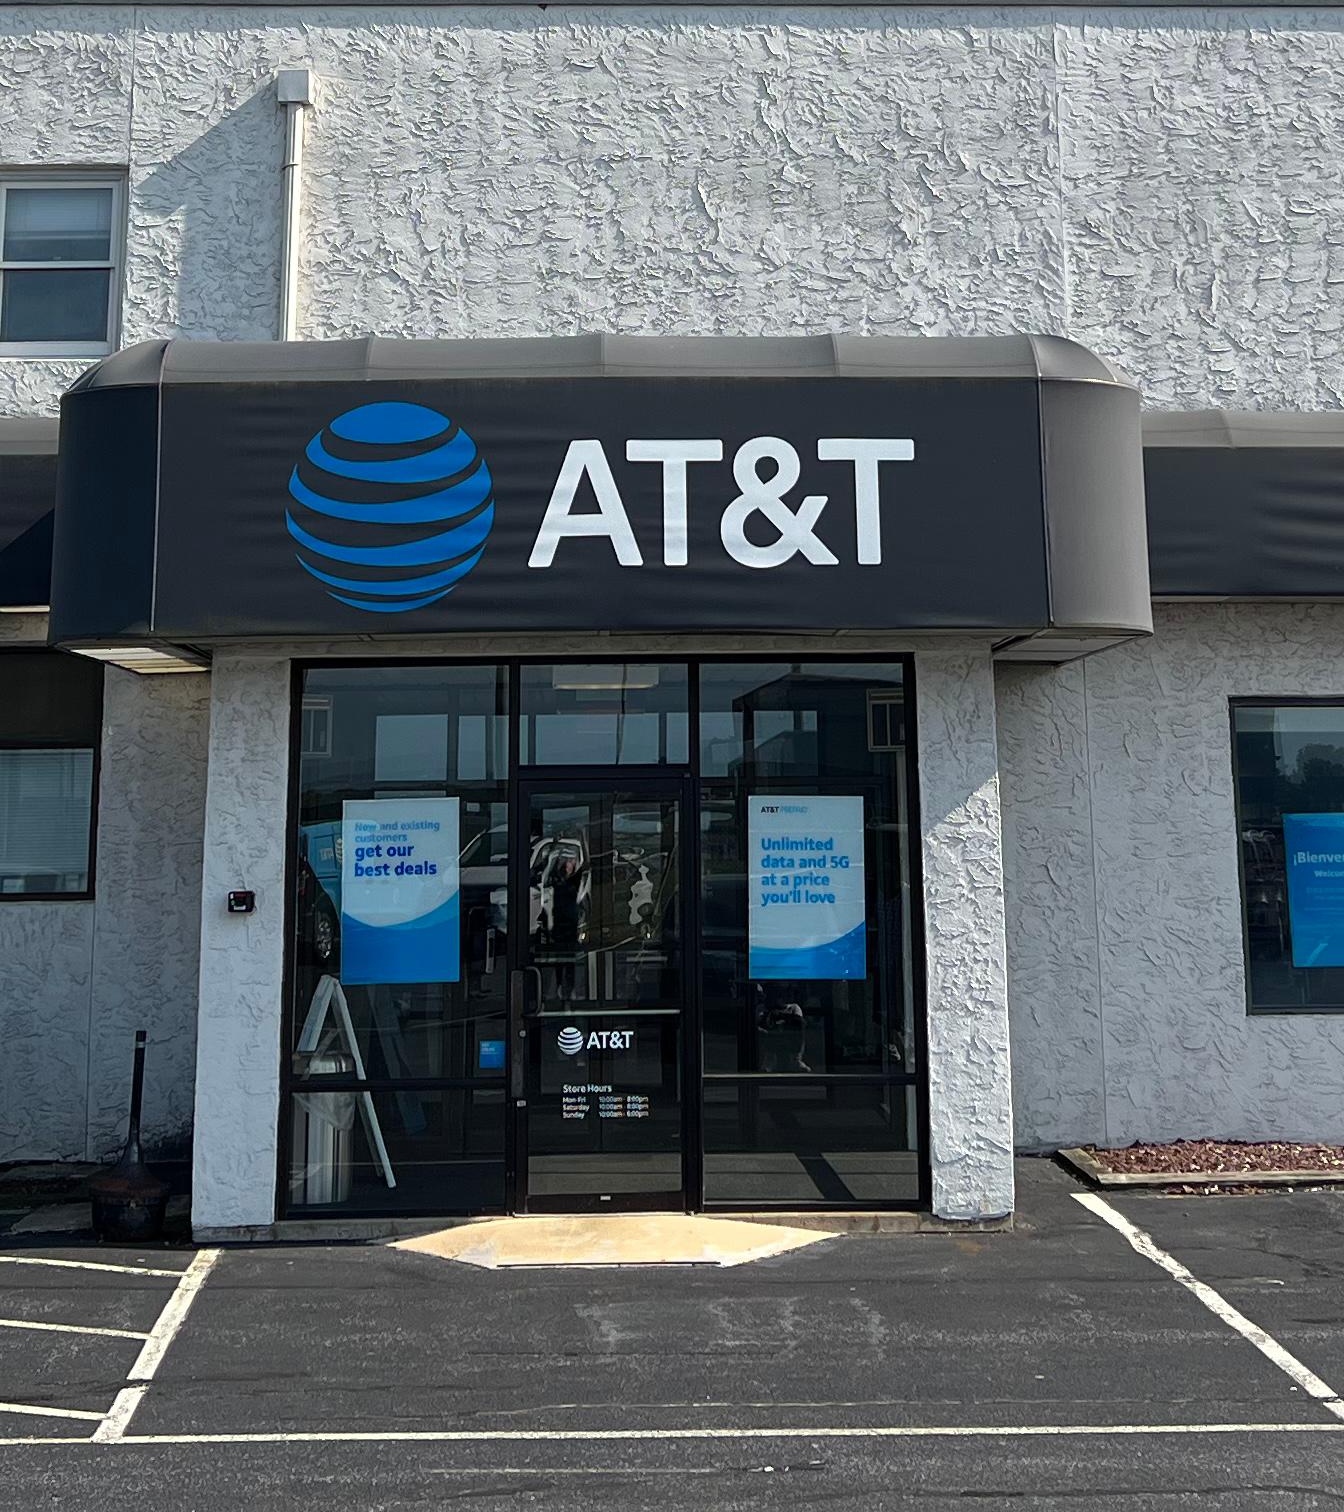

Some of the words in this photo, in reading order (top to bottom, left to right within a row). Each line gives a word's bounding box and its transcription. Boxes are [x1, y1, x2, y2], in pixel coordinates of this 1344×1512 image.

[527, 436, 915, 569] AT&T
[760, 806, 780, 814] AT&T
[379, 821, 399, 830] and
[400, 820, 441, 832] existing
[354, 834, 408, 843] customers
[761, 837, 834, 851] Unlimited
[354, 844, 383, 862] get
[386, 845, 415, 857] our
[761, 854, 795, 868] data
[799, 855, 827, 868] and
[830, 855, 850, 868] 5G
[354, 862, 391, 877] best
[394, 860, 438, 876] deals
[761, 873, 777, 886] at
[780, 875, 789, 886] a
[793, 872, 830, 890] price
[761, 890, 801, 907] you'll
[805, 890, 836, 904] love
[586, 1031, 635, 1049] AT&T
[563, 1084, 586, 1093] Store
[587, 1084, 612, 1093] Hours
[562, 1104, 590, 1112] Saturday
[562, 1111, 585, 1120] Sunday
